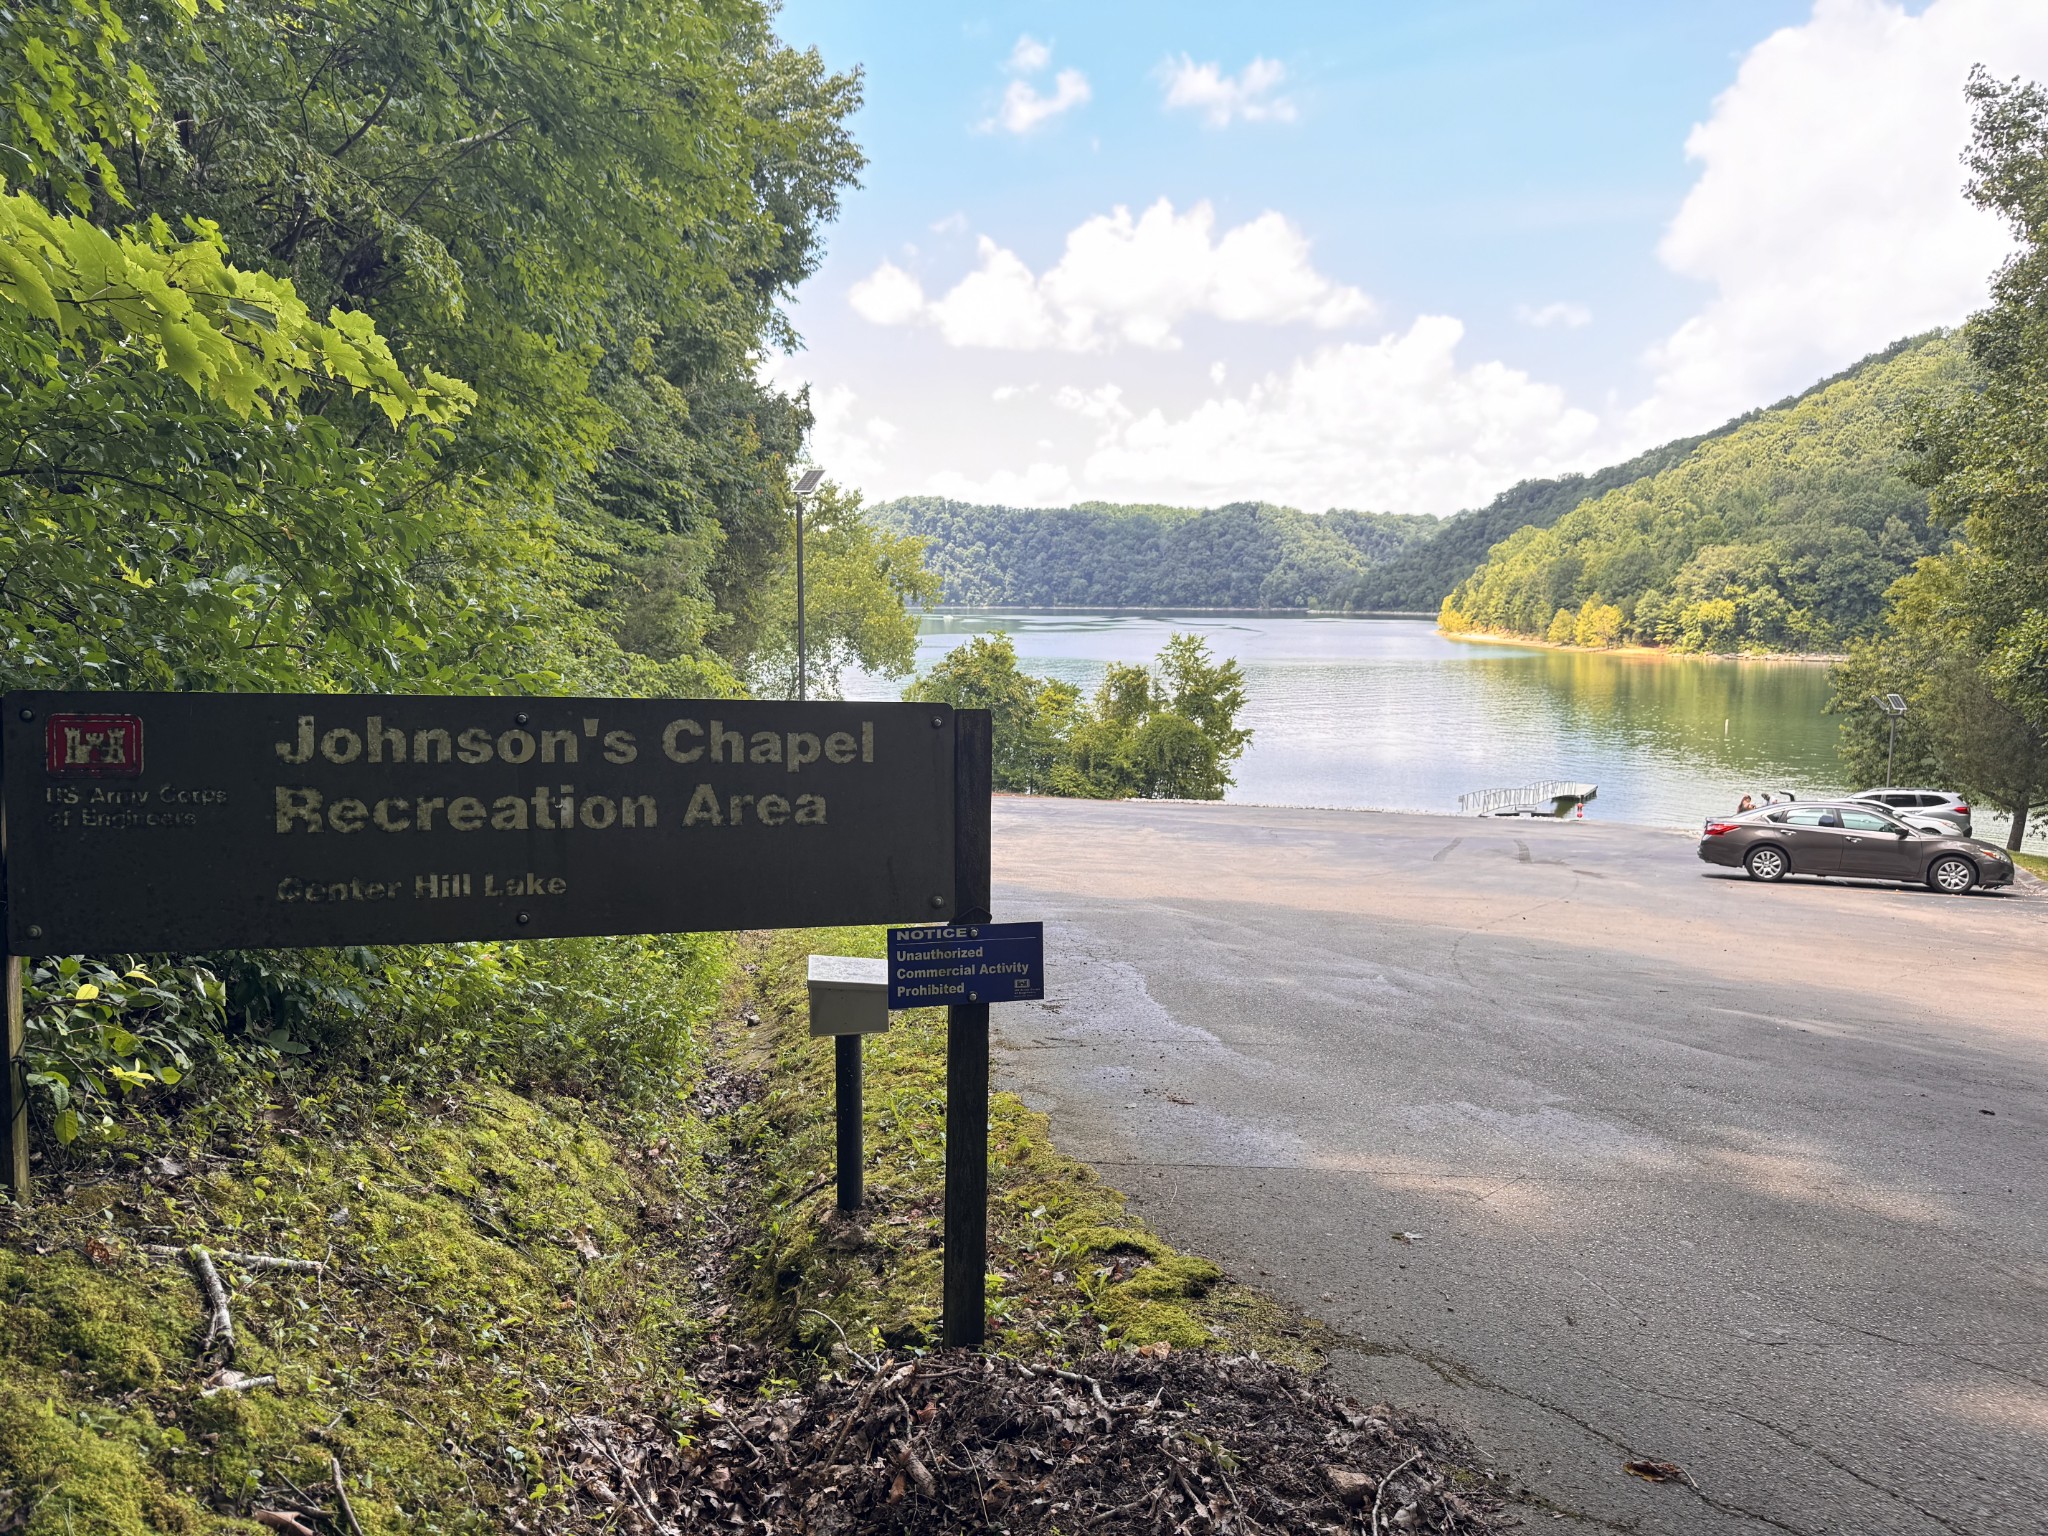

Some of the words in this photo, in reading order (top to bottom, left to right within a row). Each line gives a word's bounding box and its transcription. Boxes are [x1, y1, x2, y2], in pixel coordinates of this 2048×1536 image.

[275, 716, 638, 764] Johnson's
[662, 718, 874, 772] Chapel
[160, 784, 227, 806] Corps
[275, 784, 658, 833] Recreation
[681, 783, 828, 827] Area
[277, 876, 401, 901] Center
[414, 873, 471, 898] Hill
[485, 872, 567, 897] Lake
[896, 927, 967, 941] NOTICE
[896, 946, 983, 962] Unauthorized
[896, 964, 976, 980] Commercial
[979, 961, 1029, 976] Activity
[897, 982, 965, 997] Prohibited
